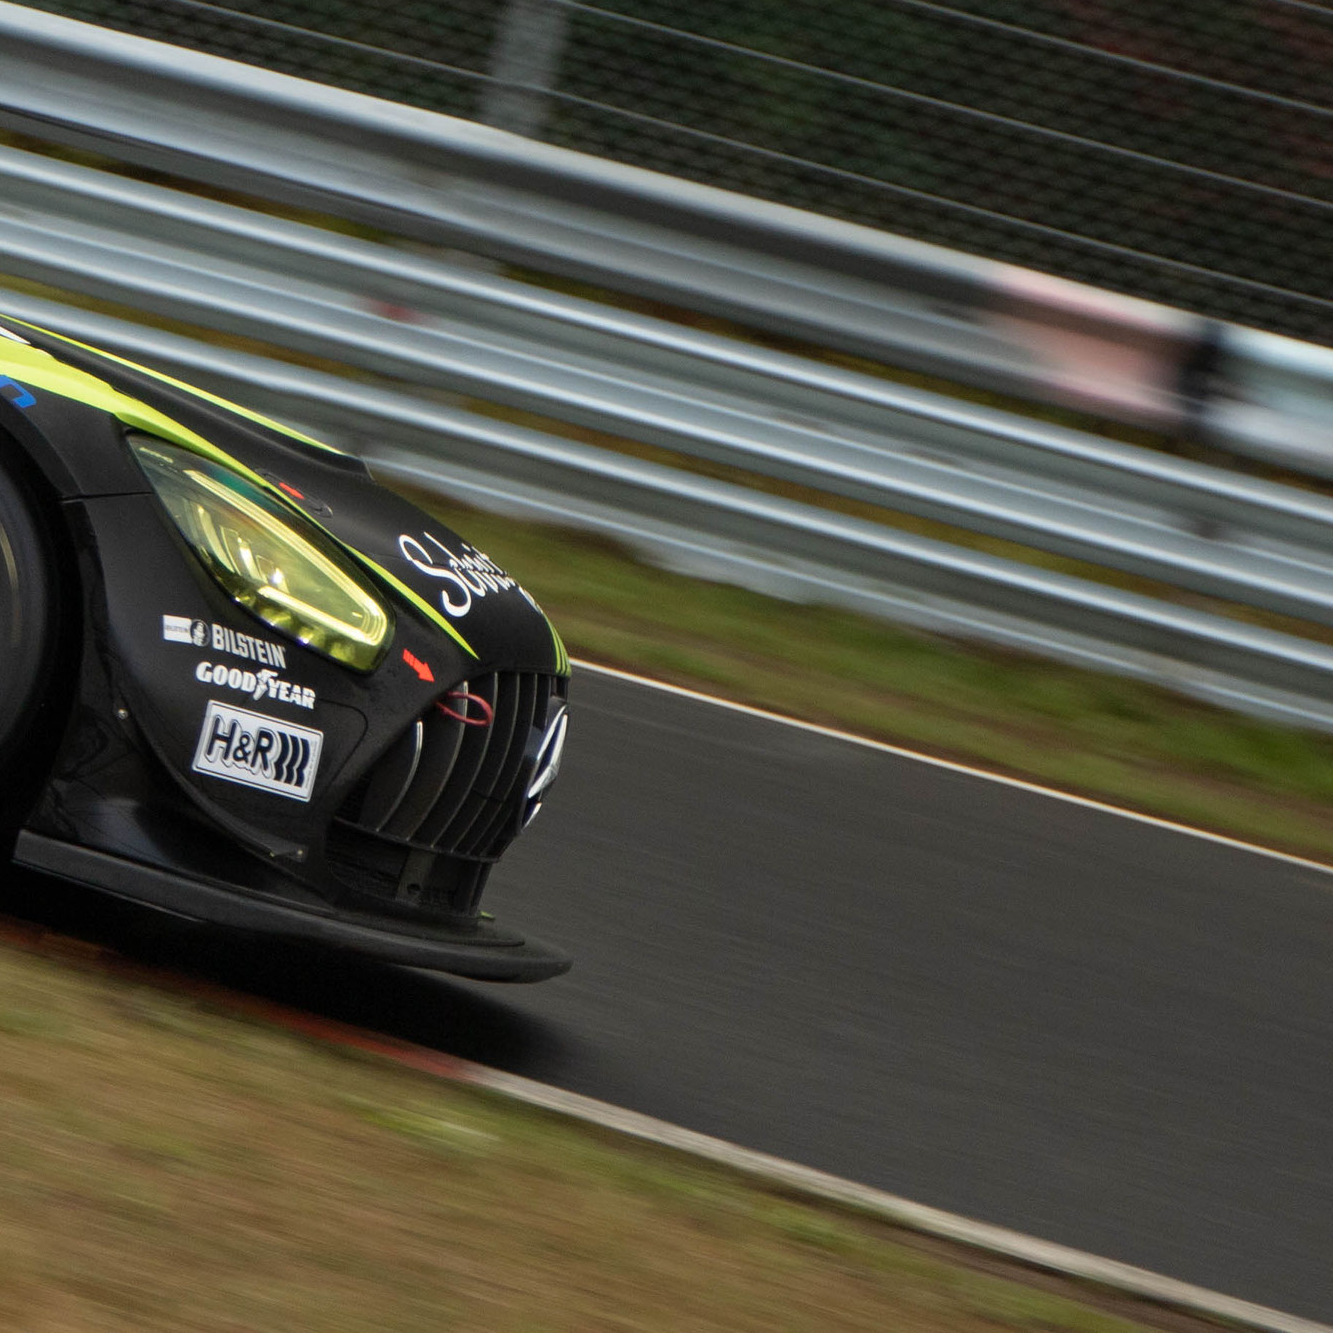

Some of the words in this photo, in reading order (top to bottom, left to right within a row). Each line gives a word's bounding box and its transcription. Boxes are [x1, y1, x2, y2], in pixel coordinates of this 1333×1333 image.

[211, 623, 287, 670] BILSTEIN
[195, 661, 317, 710] GOODYEAR
[204, 714, 277, 779] H&R
